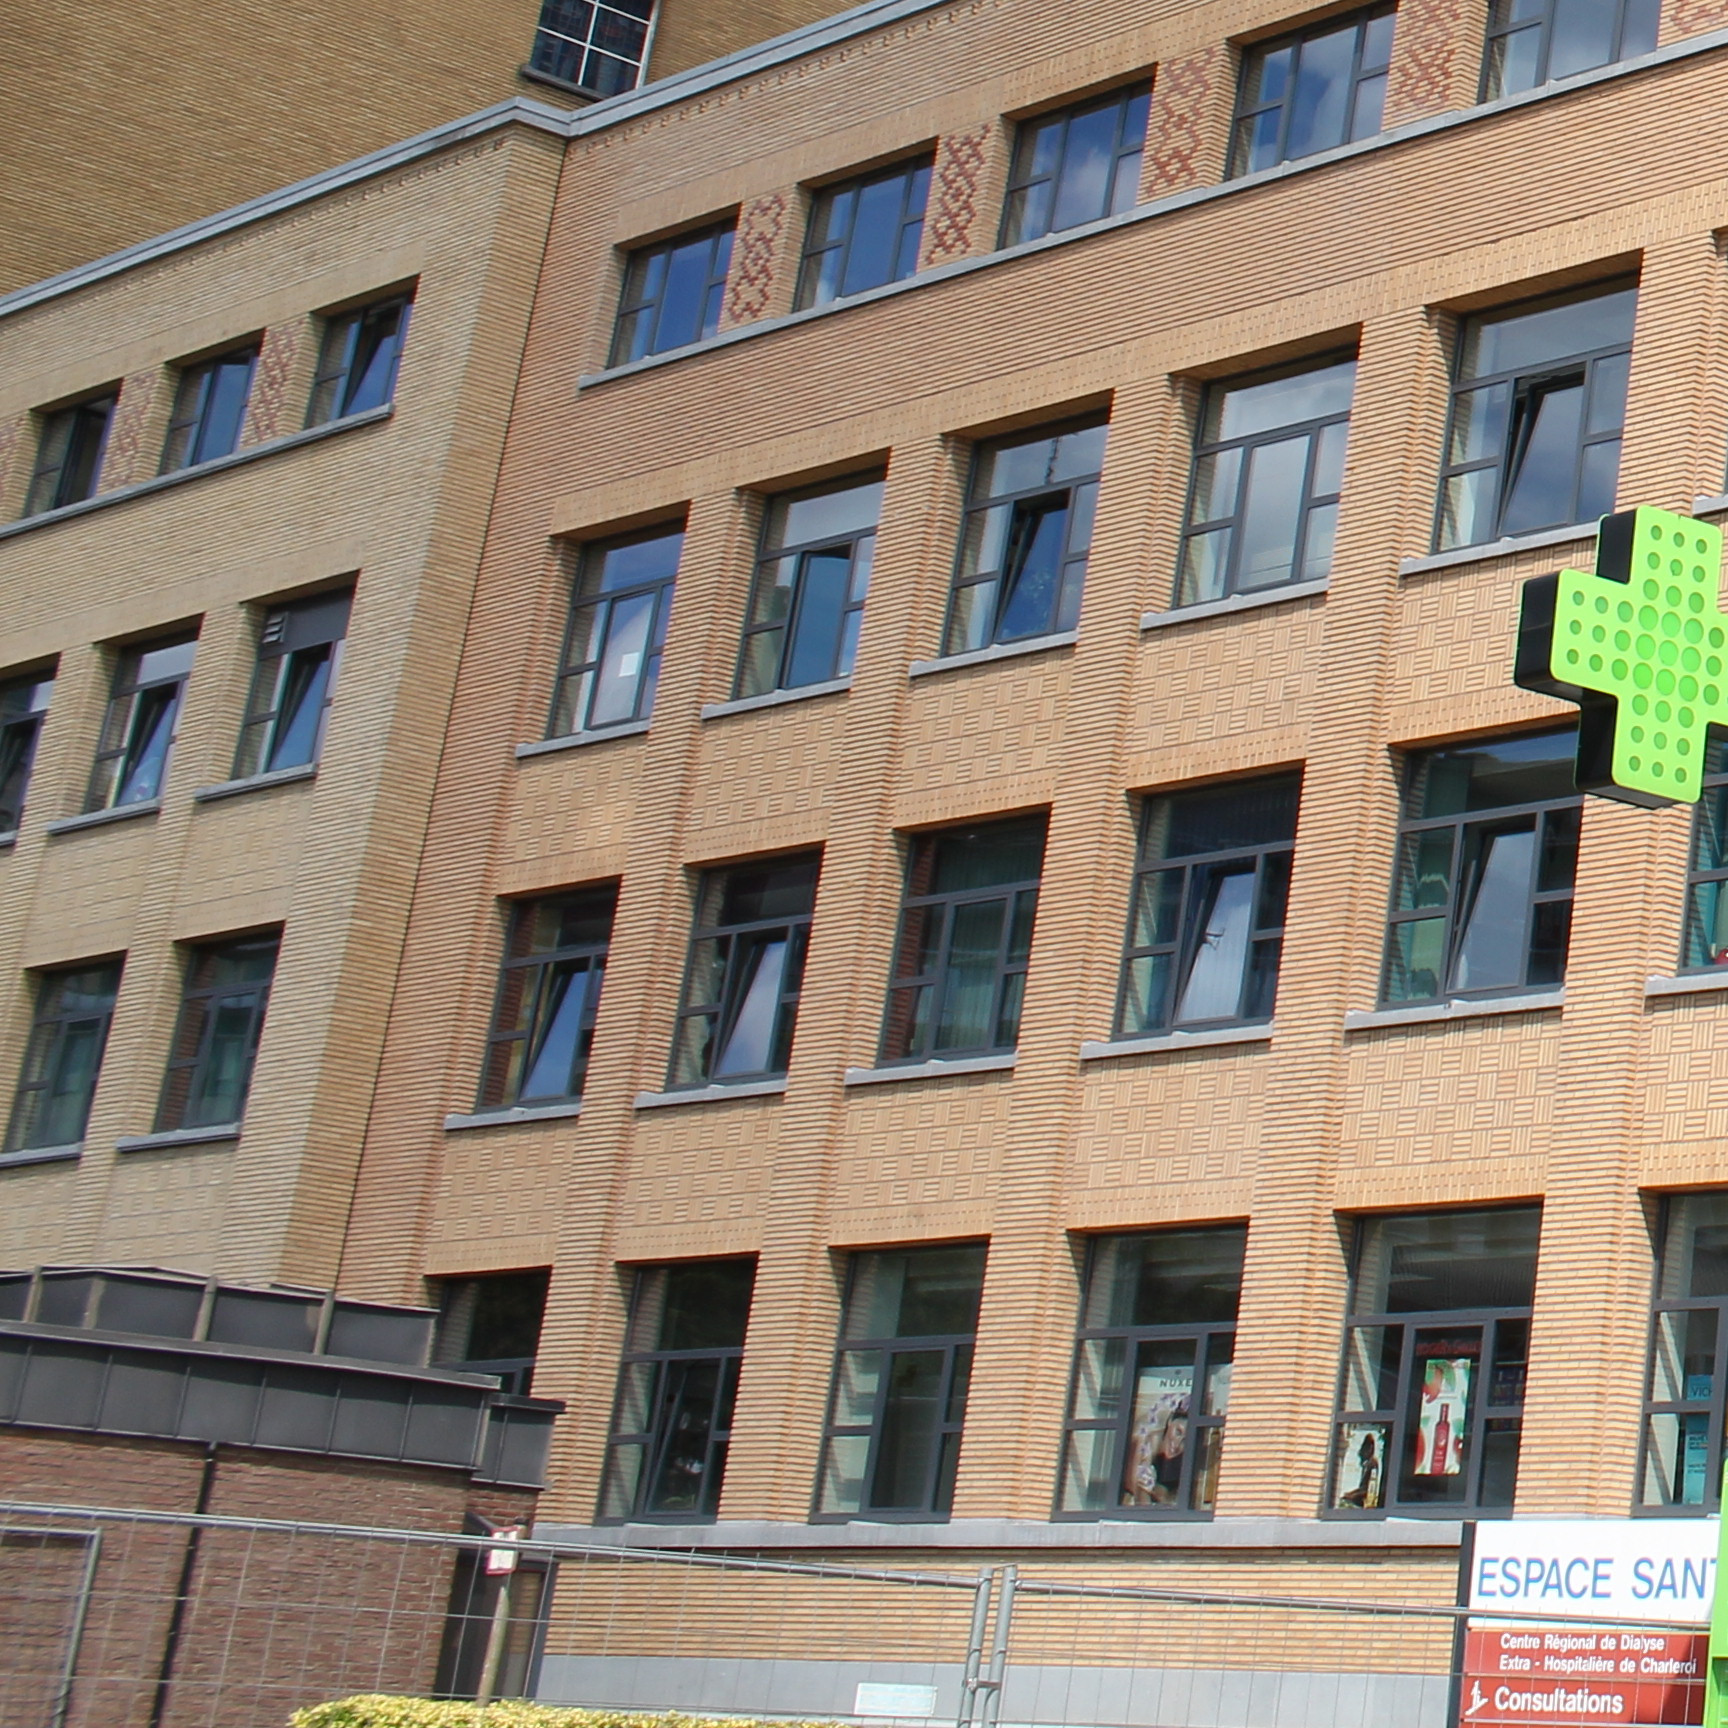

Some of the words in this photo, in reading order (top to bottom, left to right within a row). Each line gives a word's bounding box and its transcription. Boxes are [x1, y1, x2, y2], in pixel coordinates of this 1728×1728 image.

[1477, 1556, 1614, 1599] ESPACE
[1501, 1632, 1540, 1650] Centre
[1543, 1632, 1597, 1653] Régional
[1600, 1634, 1617, 1650] de
[1620, 1634, 1665, 1653] Dialyse
[1499, 1654, 1531, 1671] Extra
[1543, 1654, 1614, 1674] Hospitalière
[1619, 1656, 1636, 1673] de
[1640, 1657, 1697, 1674] Charleroi
[1494, 1685, 1624, 1714] Consultations
